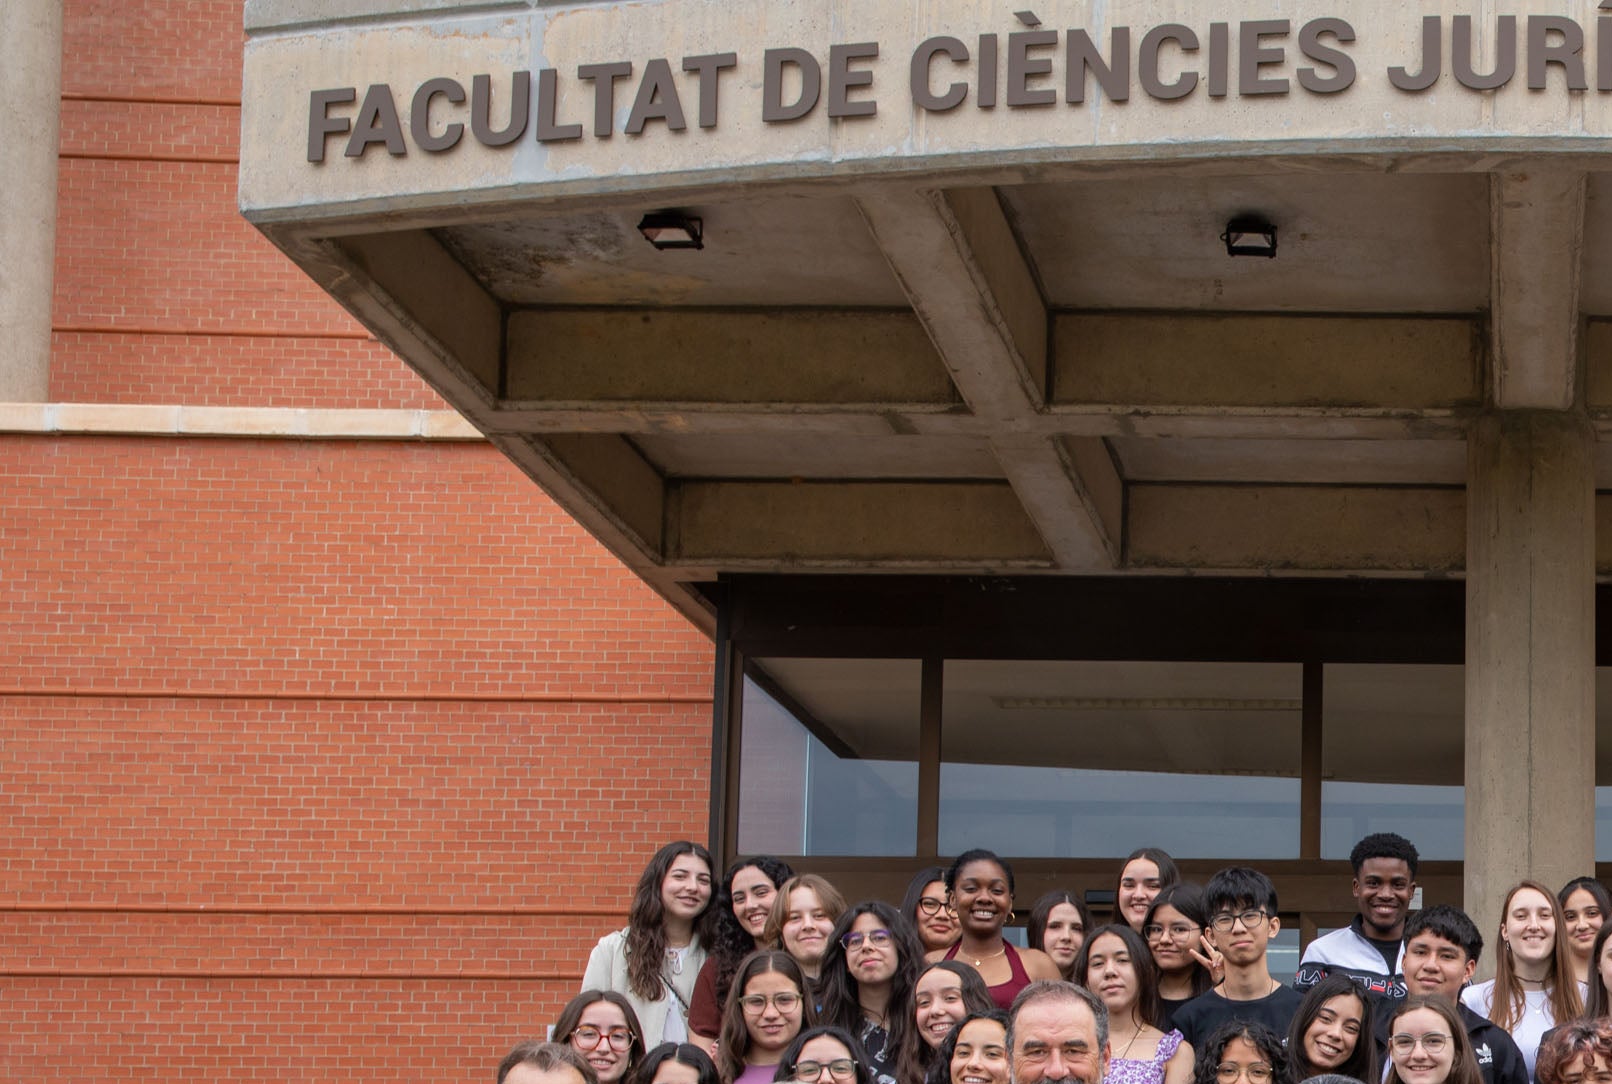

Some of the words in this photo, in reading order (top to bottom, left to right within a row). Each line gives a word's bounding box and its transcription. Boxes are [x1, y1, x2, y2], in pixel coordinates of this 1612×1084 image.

[307, 52, 737, 163] FACULTAT
[762, 41, 879, 123] DE
[910, 10, 1356, 112] CIÈNCIES
